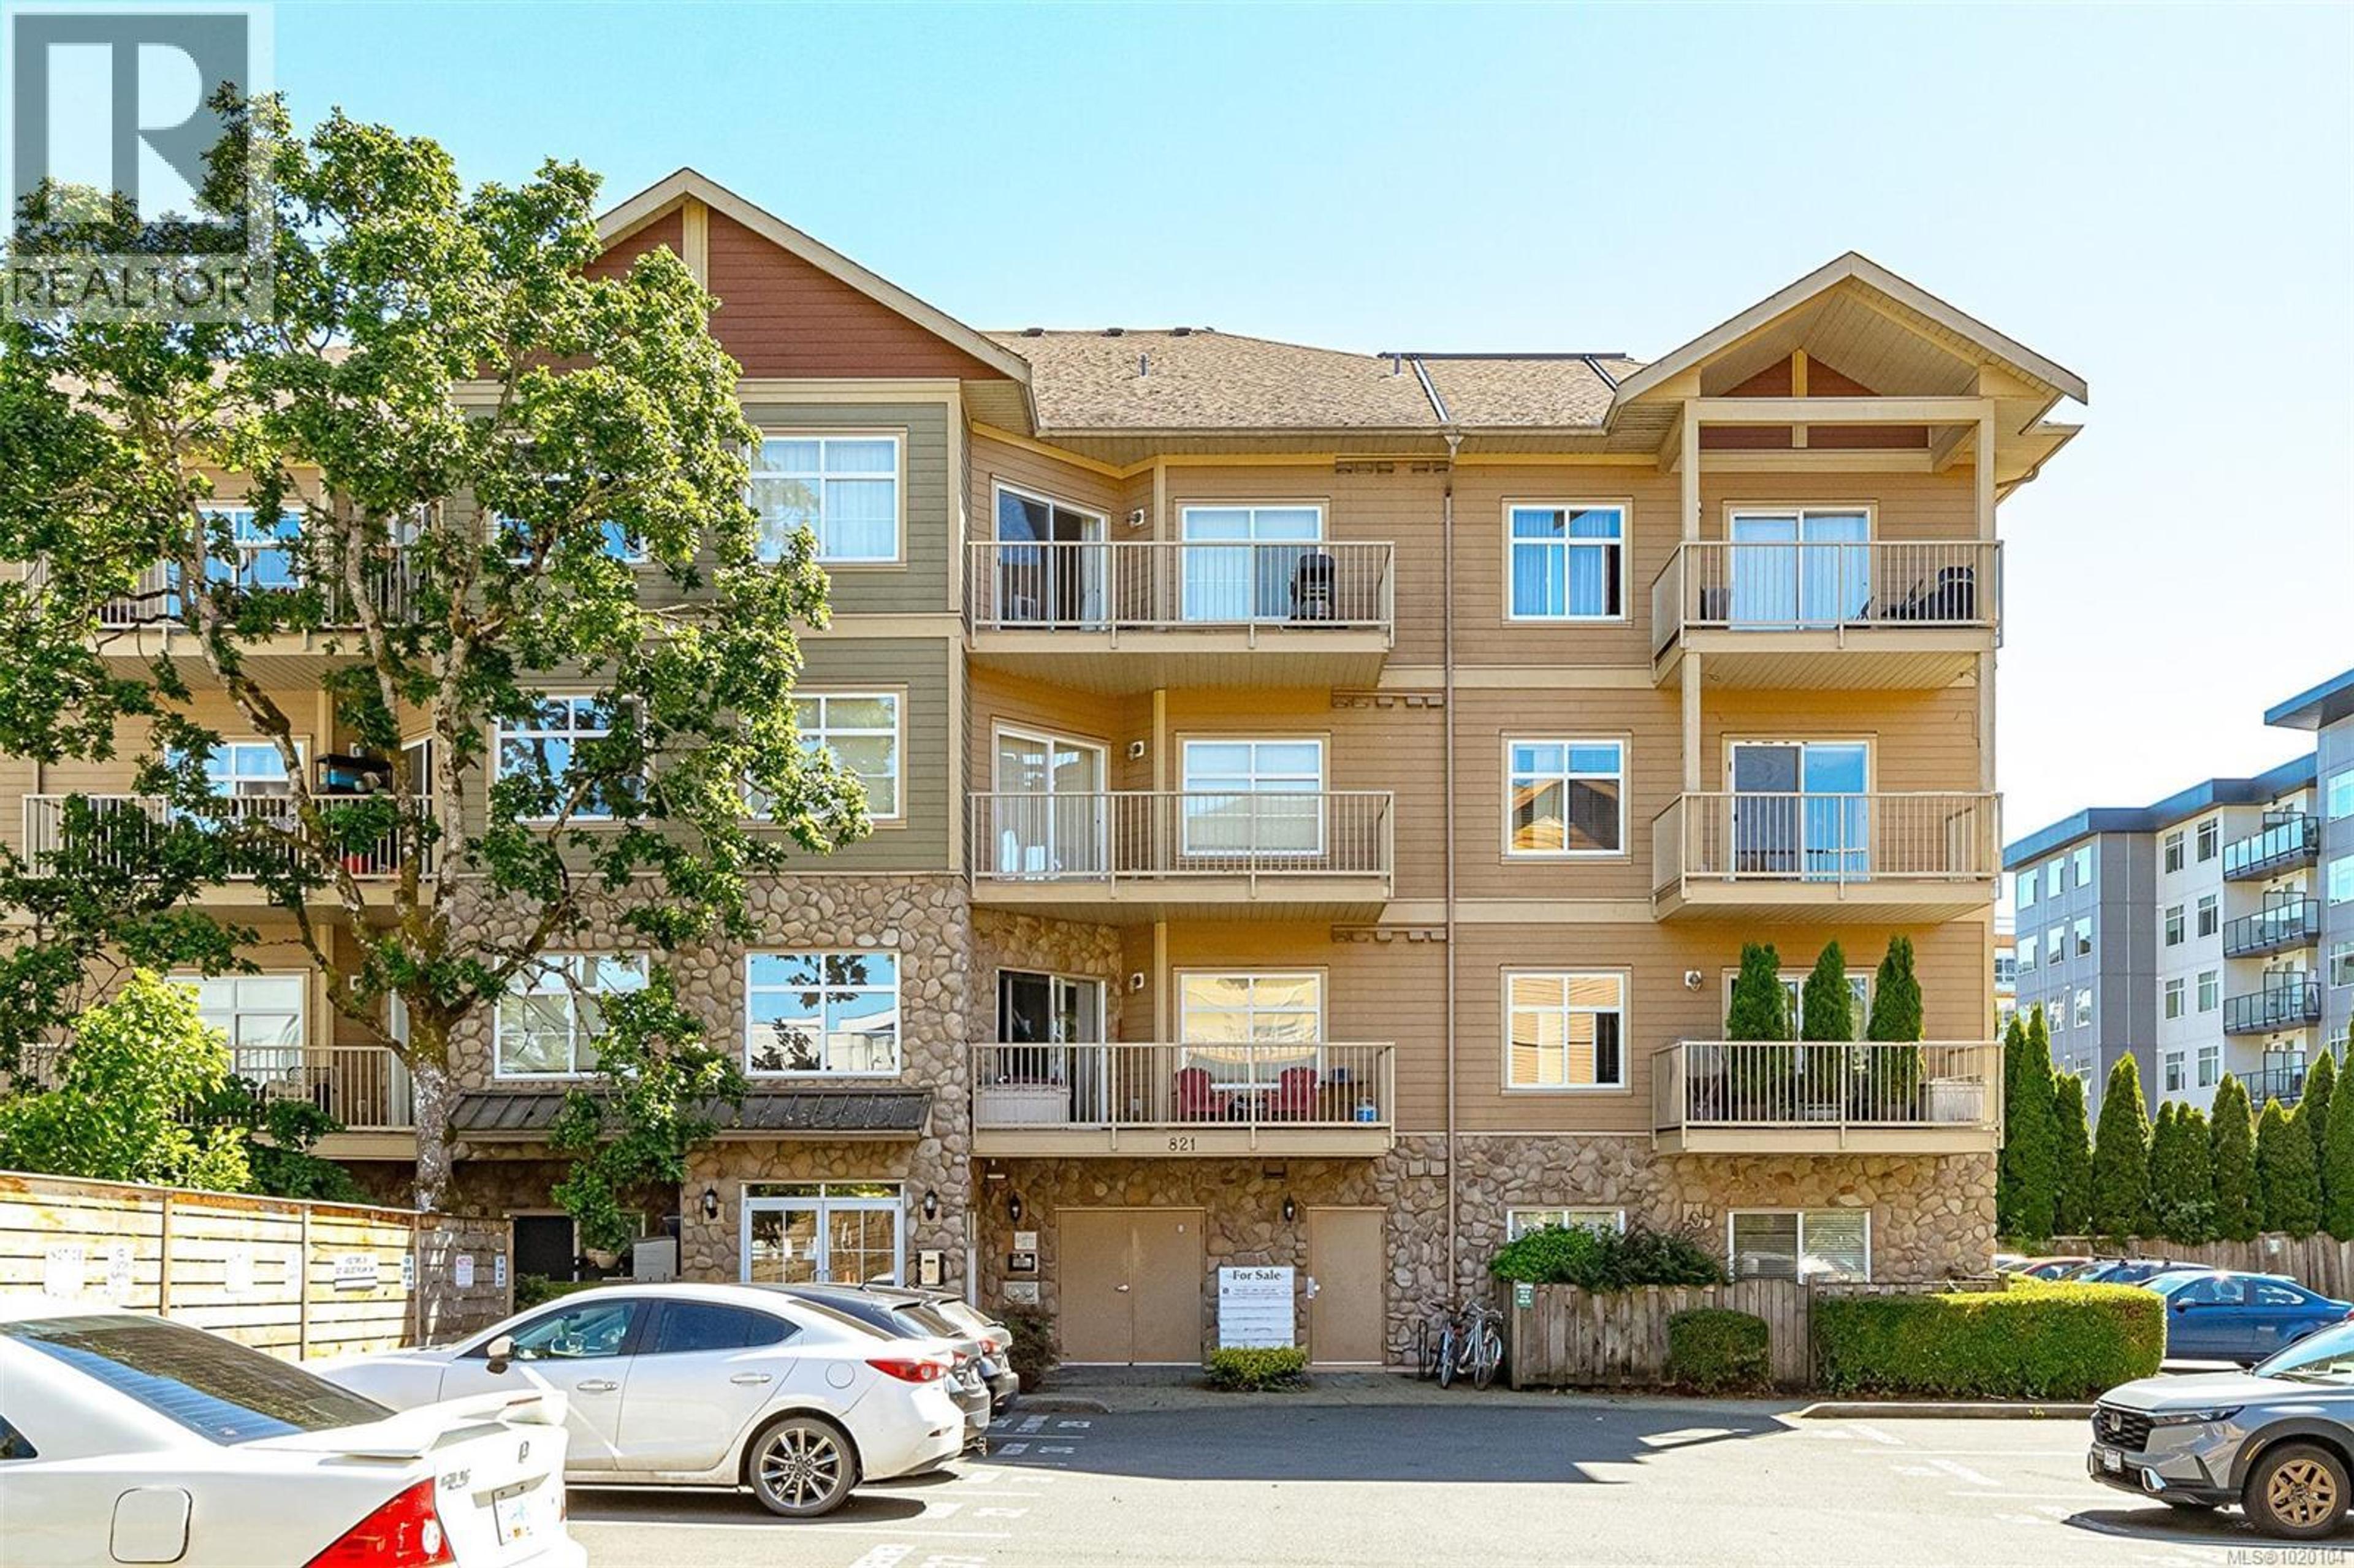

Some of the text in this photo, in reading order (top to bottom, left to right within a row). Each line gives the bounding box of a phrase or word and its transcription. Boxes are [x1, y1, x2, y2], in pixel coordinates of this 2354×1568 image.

[1168, 1137, 1195, 1151] 821
[1233, 1269, 1281, 1280] For Sale
